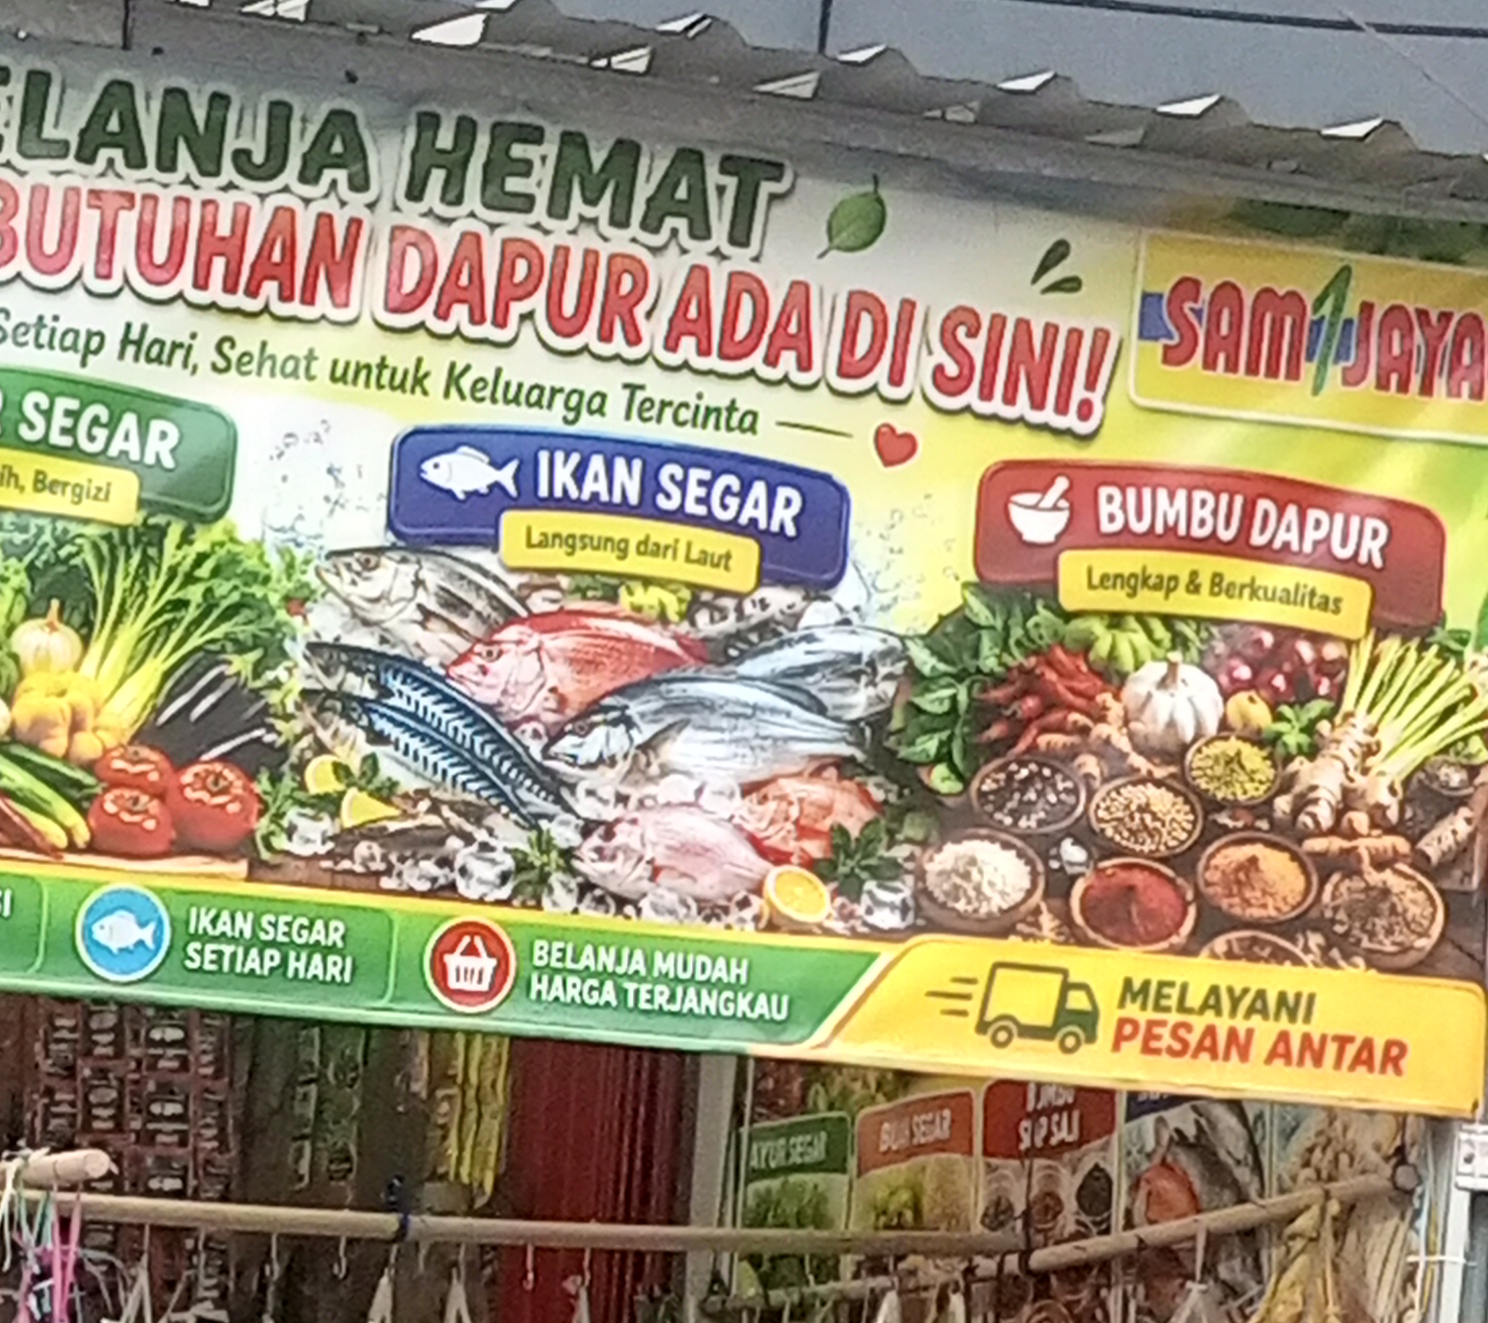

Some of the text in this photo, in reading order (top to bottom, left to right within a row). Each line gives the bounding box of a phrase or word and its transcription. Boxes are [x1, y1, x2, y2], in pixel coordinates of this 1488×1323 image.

[403, 110, 786, 250] HEMAT
[384, 223, 649, 347] DAPUR
[663, 263, 814, 374] ADA
[835, 289, 916, 387] DI
[930, 304, 1112, 424] SINI!
[118, 329, 201, 376] Hari,
[210, 335, 319, 383] Sehat
[328, 354, 431, 398] untuk
[442, 362, 608, 426] Keluarga
[620, 383, 760, 437] Tercinta
[16, 406, 182, 471] SEGAR
[32, 469, 113, 507] Bergizi
[536, 449, 804, 538] IKAN SEGAR
[524, 524, 733, 573] Langsung dari Laut
[1096, 484, 1390, 570] BUMBU DAPUR
[1086, 564, 1344, 617] Lengkap & Berkualitas
[187, 906, 347, 950] IKAN SEGAR
[183, 942, 356, 986] SETIAP HARI
[532, 940, 750, 986] BELANJA MUDAH
[528, 971, 791, 1023] HARGA TERJANGKAU
[1116, 976, 1318, 1028] MELAYANI
[1109, 1016, 1411, 1079] PESAN ANTAR
